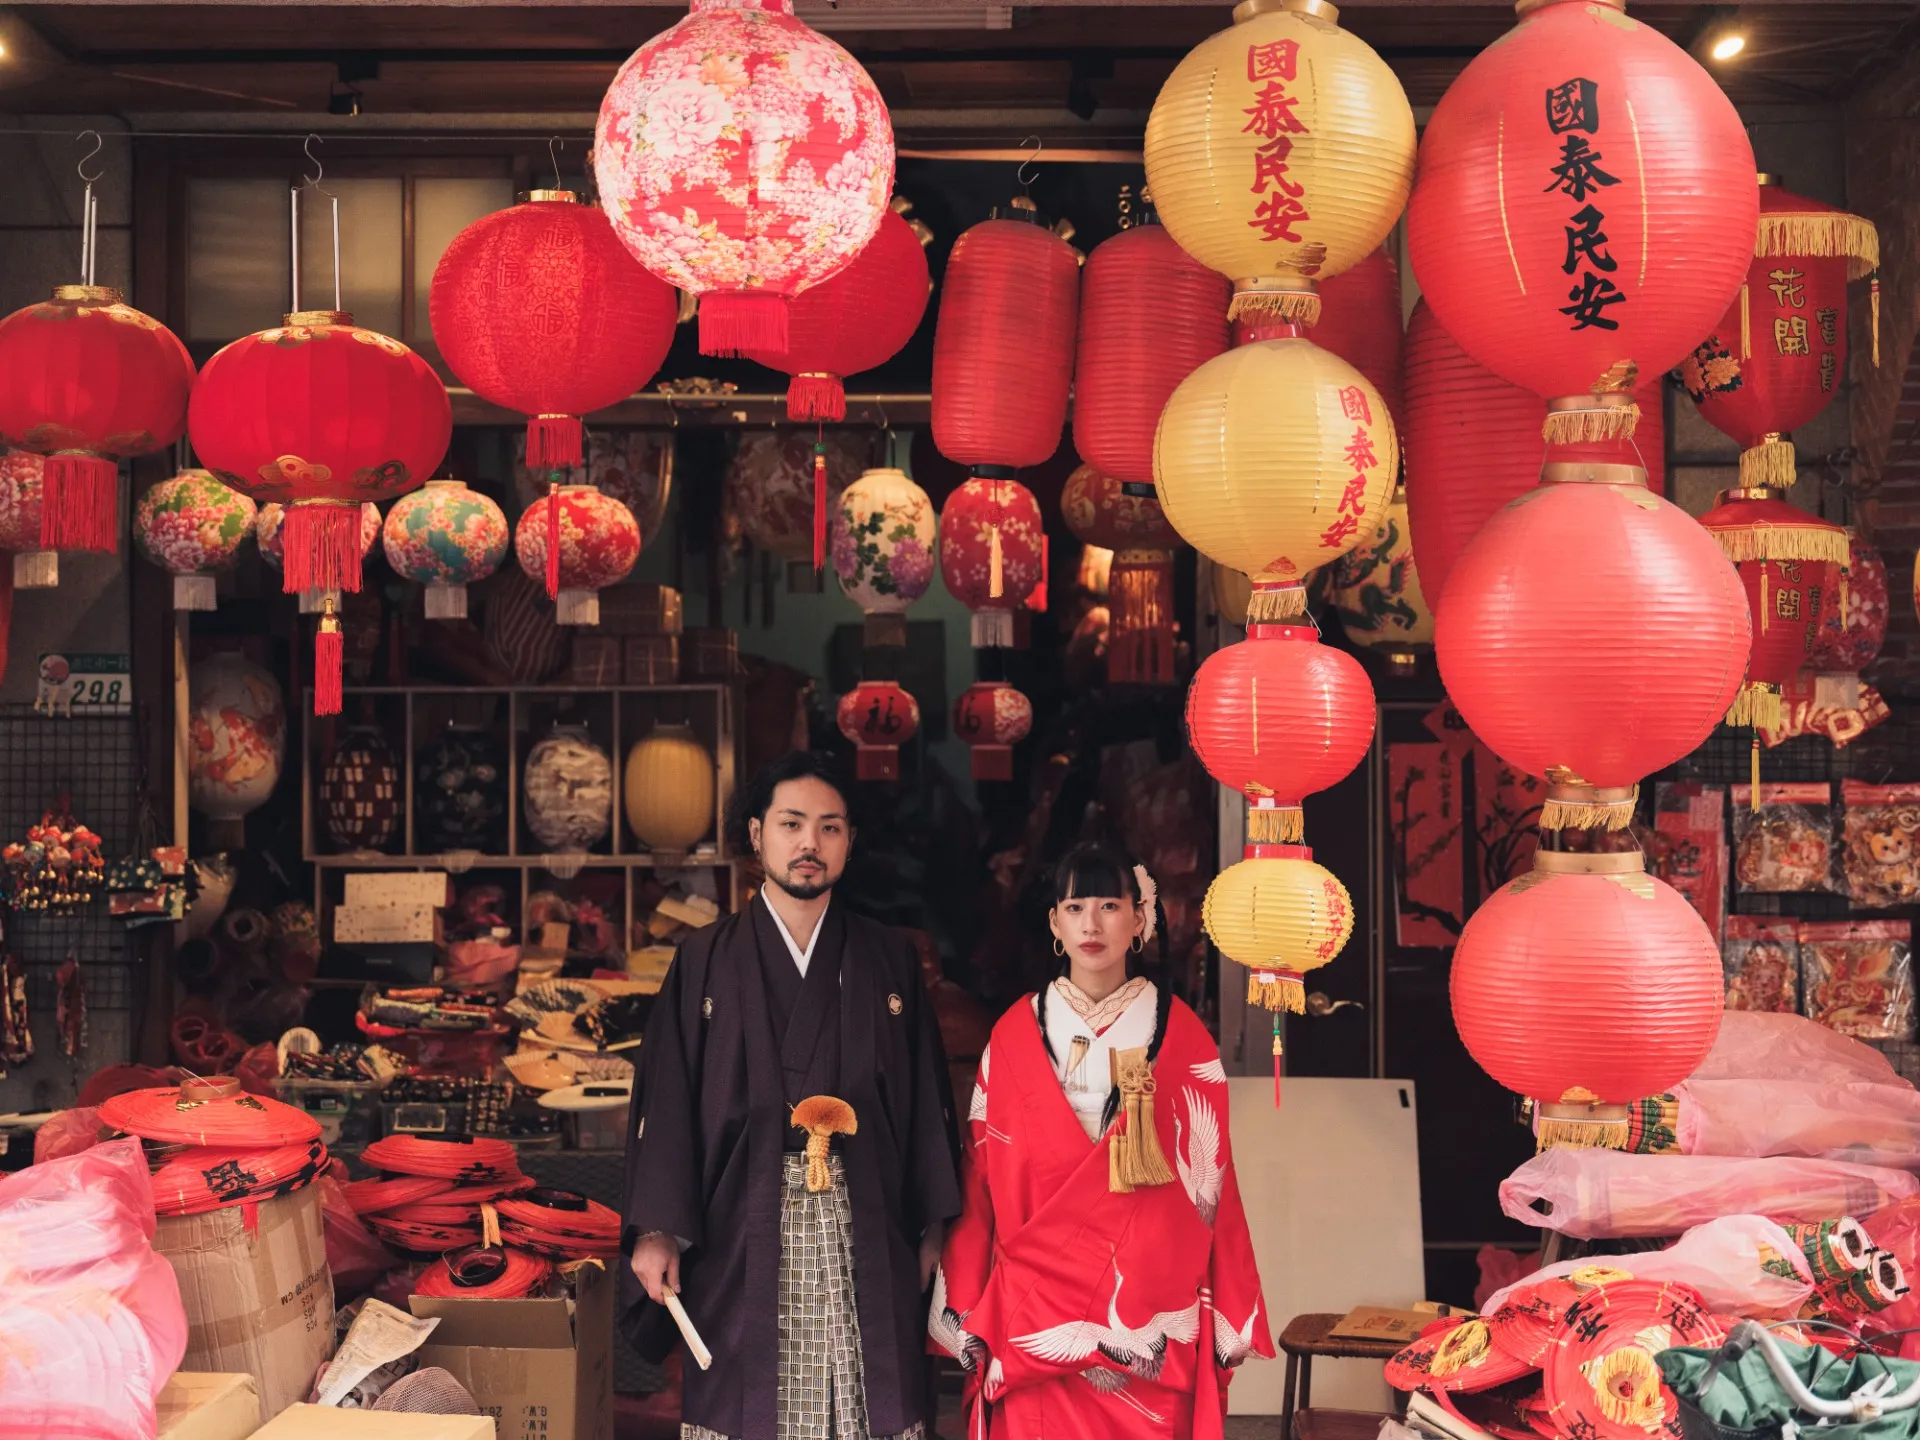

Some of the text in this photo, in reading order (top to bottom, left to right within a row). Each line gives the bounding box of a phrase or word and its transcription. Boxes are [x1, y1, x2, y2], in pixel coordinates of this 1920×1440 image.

[1241, 38, 1311, 244] 國泰民安
[1543, 77, 1627, 332] 國泰民安
[1767, 267, 1810, 357] 花開
[1815, 306, 1838, 393] 富貴
[1319, 384, 1379, 548] 國泰民安
[71, 680, 122, 705] 298
[864, 696, 903, 736] 福
[280, 1291, 294, 1306] CM
[304, 1305, 316, 1319] KGS
[522, 1406, 547, 1417] G.W.:
[522, 1420, 547, 1431] N.W.:
